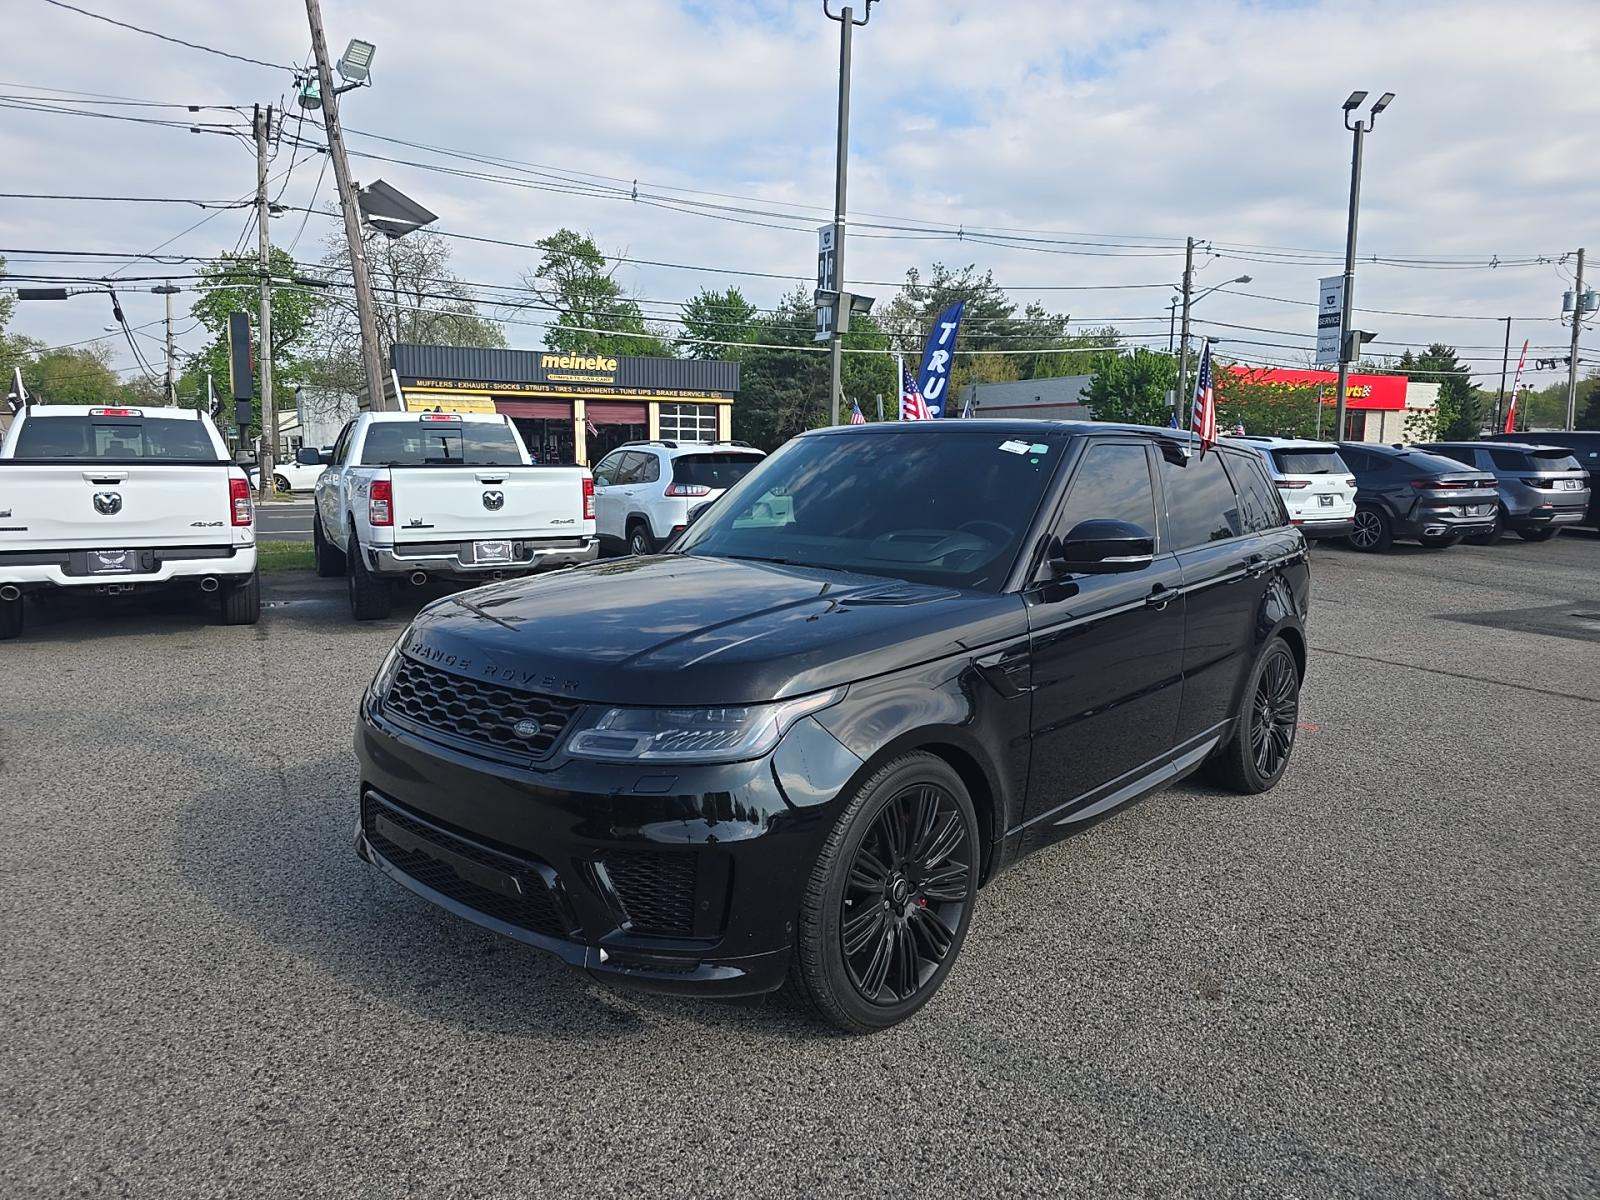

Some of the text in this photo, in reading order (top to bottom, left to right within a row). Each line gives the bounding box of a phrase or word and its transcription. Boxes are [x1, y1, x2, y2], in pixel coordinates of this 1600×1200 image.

[1319, 315, 1340, 326] SERVICE
[541, 351, 618, 371] meineke
[416, 380, 453, 388] MUFFLERS
[458, 381, 489, 389] EXHAUST
[493, 383, 521, 391] SHOCKS
[525, 384, 550, 392] STRUTS
[680, 390, 706, 398] SERVICE
[411, 643, 580, 691] RANGE ROVER
